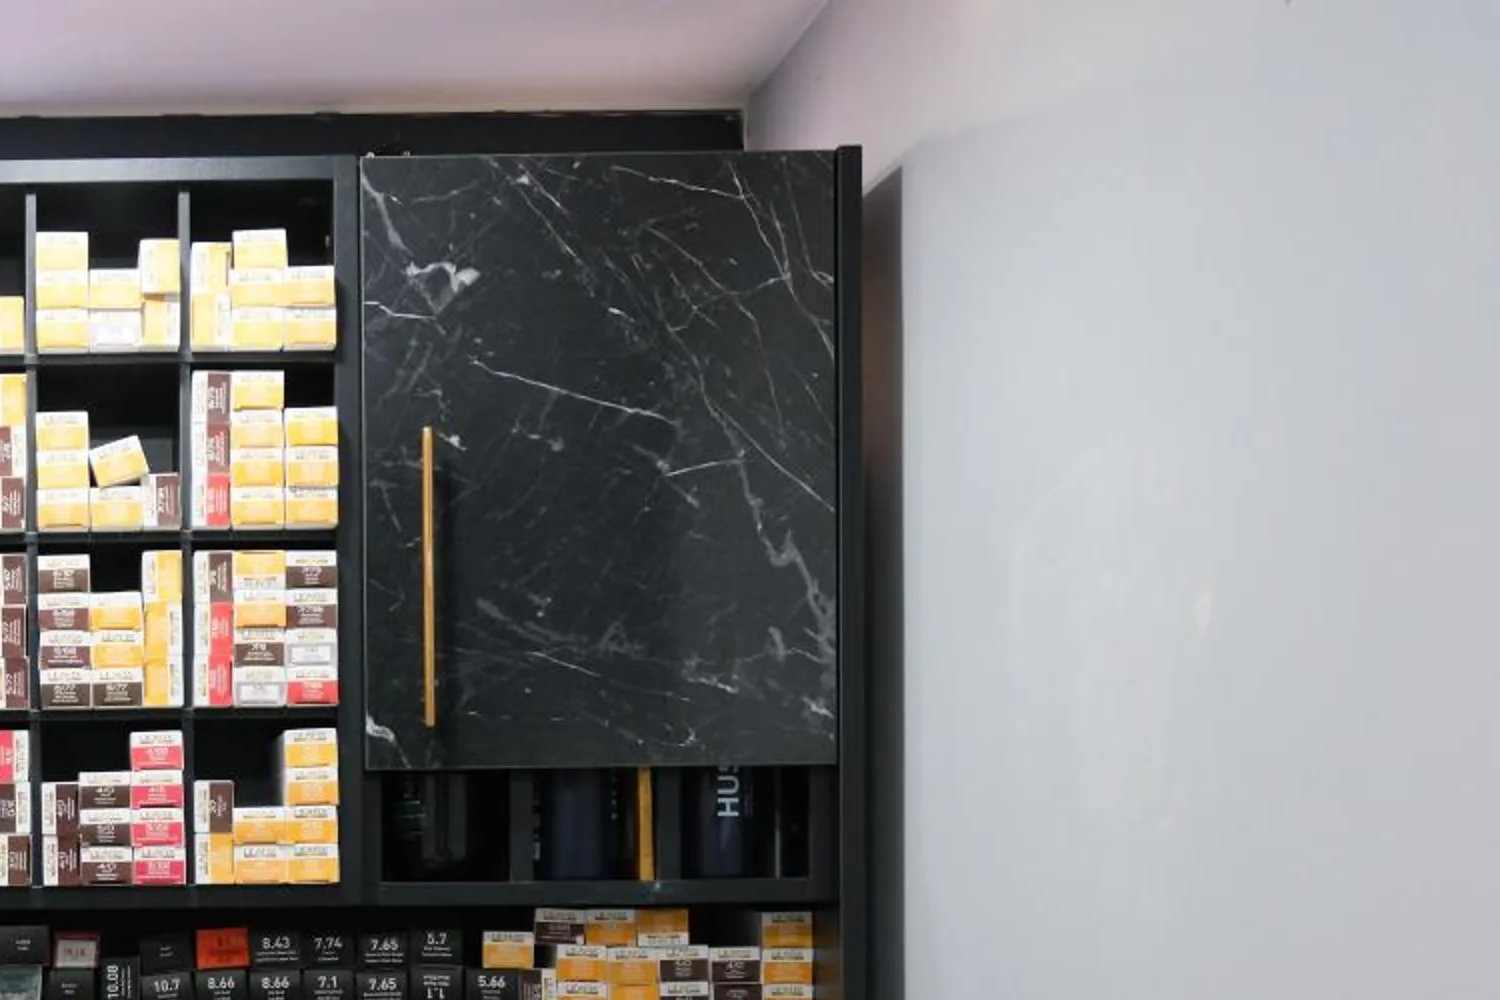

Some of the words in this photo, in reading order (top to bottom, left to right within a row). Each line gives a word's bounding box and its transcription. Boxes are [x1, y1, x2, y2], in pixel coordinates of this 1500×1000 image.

[154, 978, 181, 993] 10.7
[207, 977, 235, 989] 8.66
[261, 976, 290, 989] 8.66
[317, 976, 337, 988] 7.1
[368, 977, 397, 990] 7.65
[477, 975, 506, 988] 5.66
